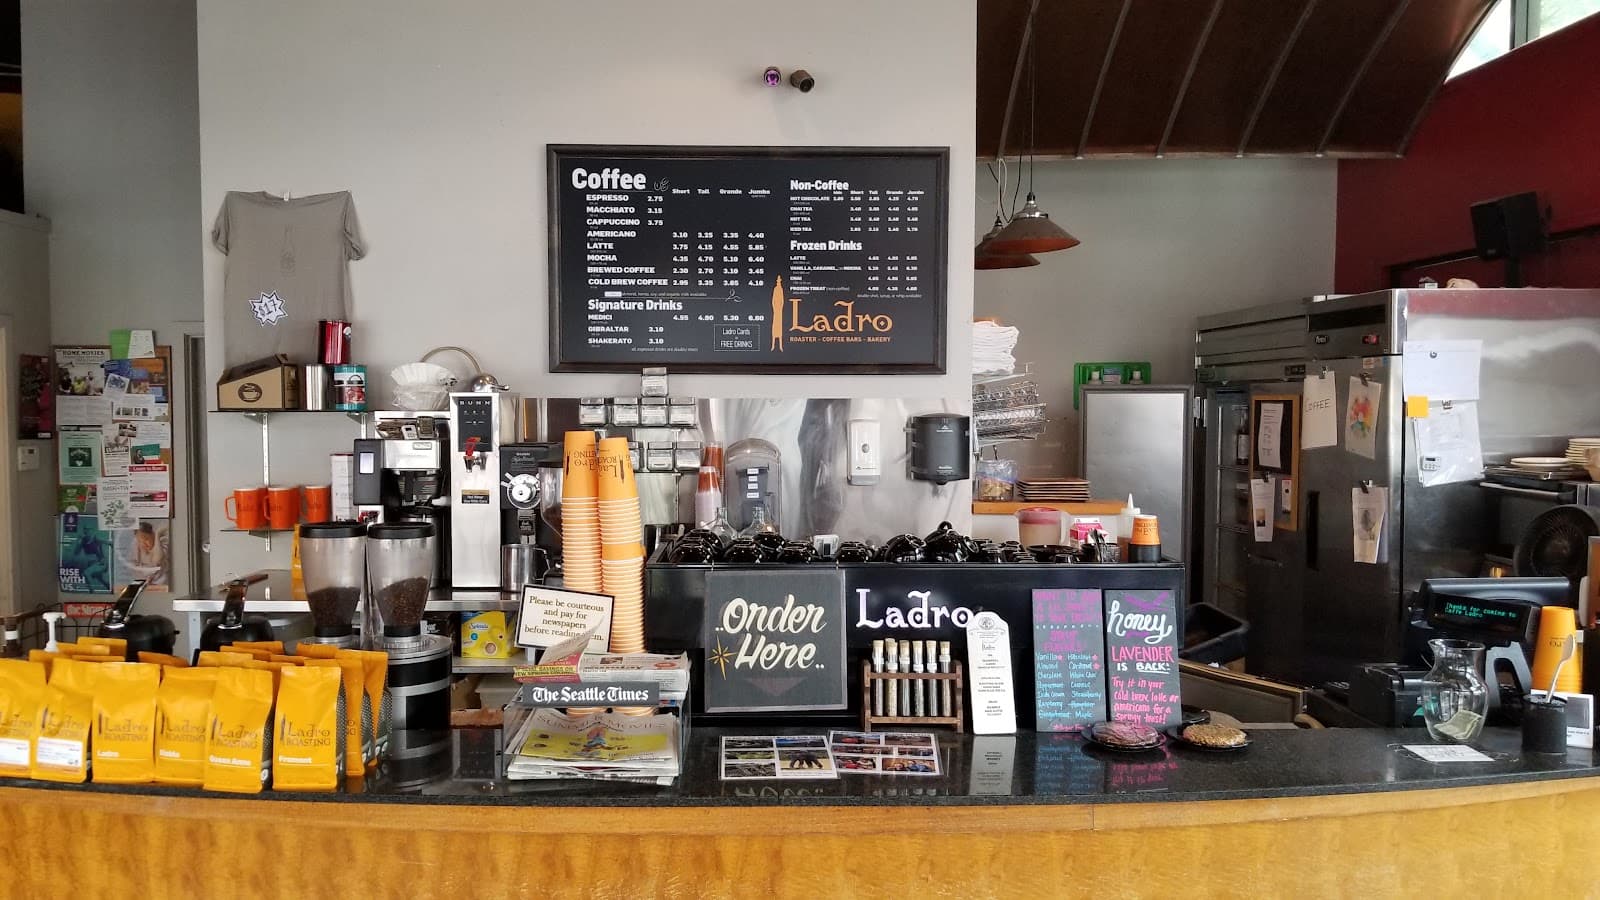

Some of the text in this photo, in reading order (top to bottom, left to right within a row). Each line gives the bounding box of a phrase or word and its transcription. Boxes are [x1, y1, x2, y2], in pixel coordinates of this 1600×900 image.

[572, 168, 646, 189] Coffee
[791, 180, 850, 191] Non-Coffee
[791, 240, 862, 250] Frozen Drinks
[588, 299, 683, 312] Signature Drinks
[789, 299, 892, 332] Ladro
[60, 568, 80, 576] RISE
[529, 596, 604, 612] Please be courteous
[856, 588, 975, 628] Ladro
[544, 609, 588, 620] and pay for
[542, 618, 587, 630] newspapers
[1107, 600, 1173, 644] honey
[524, 624, 550, 635] before
[1035, 652, 1057, 660] Vanilla
[1111, 646, 1174, 663] LAVENDER
[1117, 662, 1128, 671] IS
[1112, 676, 1165, 692] Try it in your
[533, 686, 649, 704] The Seattle Times
[1114, 690, 1128, 700] cold
[1169, 694, 1178, 702] or
[1153, 704, 1164, 714] for
[104, 716, 148, 732] Ladro
[218, 720, 258, 739] Ladro
[288, 721, 330, 738] Ladro
[287, 738, 330, 747] ROASTING
[278, 756, 312, 764] Fremont
